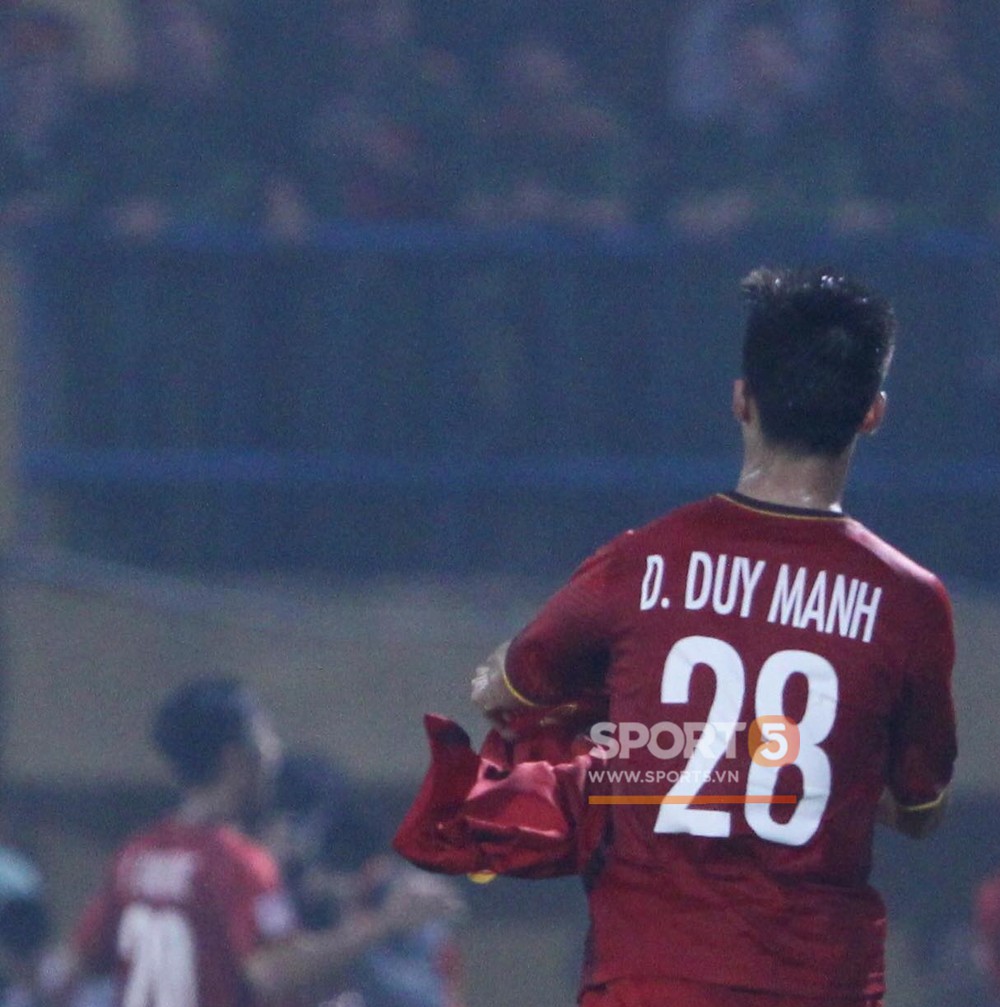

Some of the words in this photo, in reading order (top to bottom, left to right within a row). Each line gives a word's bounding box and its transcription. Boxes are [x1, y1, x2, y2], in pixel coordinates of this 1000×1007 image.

[639, 553, 671, 612] D.
[684, 550, 767, 619] DUY
[767, 563, 883, 644] MANH
[653, 634, 840, 847] 28
